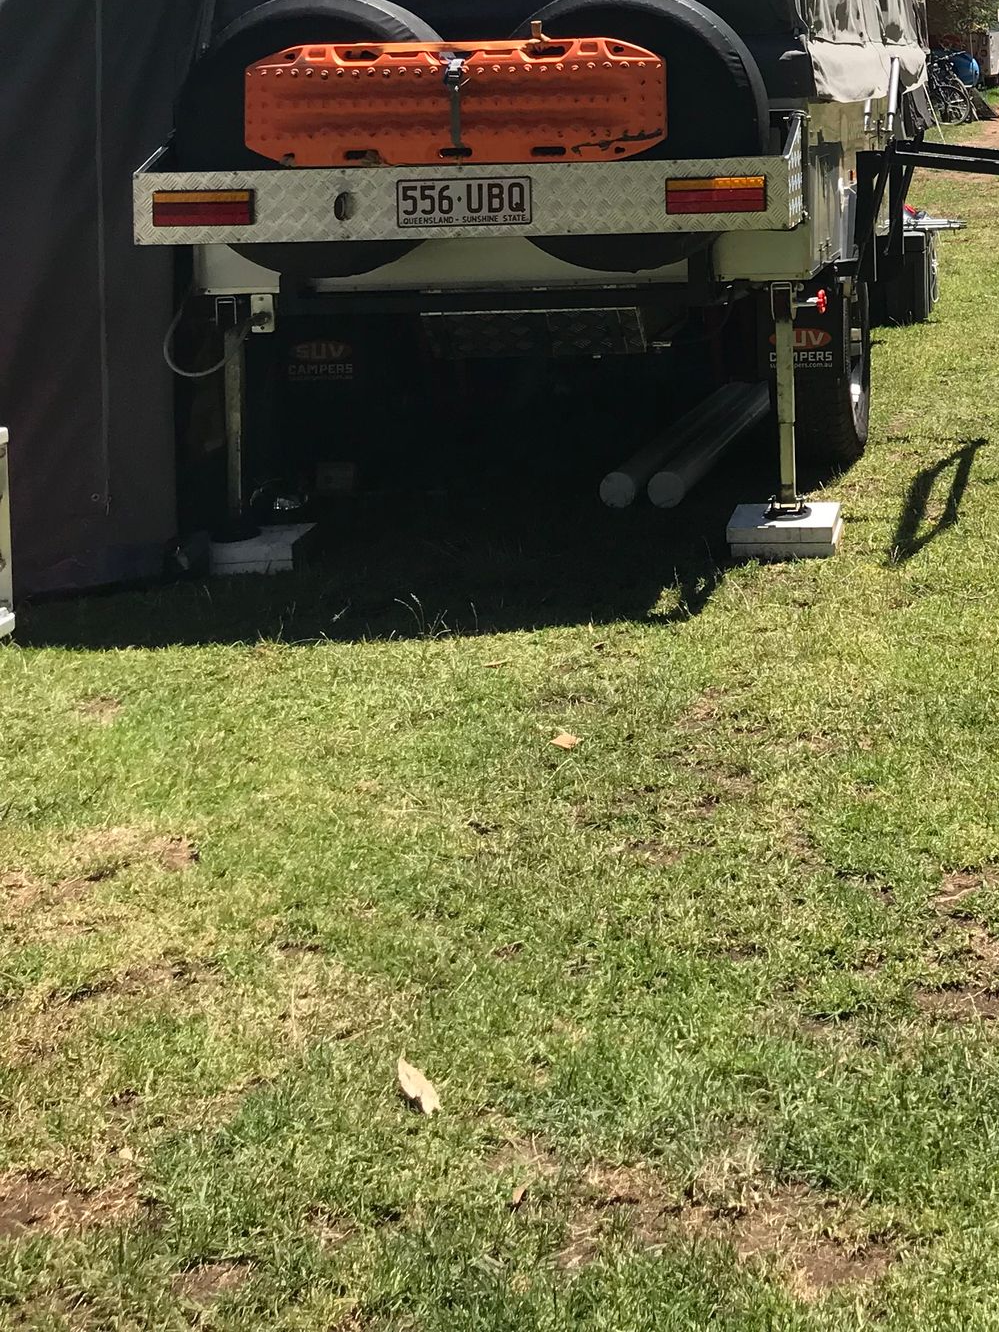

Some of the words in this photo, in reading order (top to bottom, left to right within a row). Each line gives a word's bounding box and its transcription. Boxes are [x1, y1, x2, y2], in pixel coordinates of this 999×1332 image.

[403, 216, 454, 225] QUEENSLAND
[462, 215, 498, 223] SUNSHINE
[503, 214, 526, 222] STATE
[792, 330, 825, 347] UV
[288, 363, 353, 375] CAMPERS
